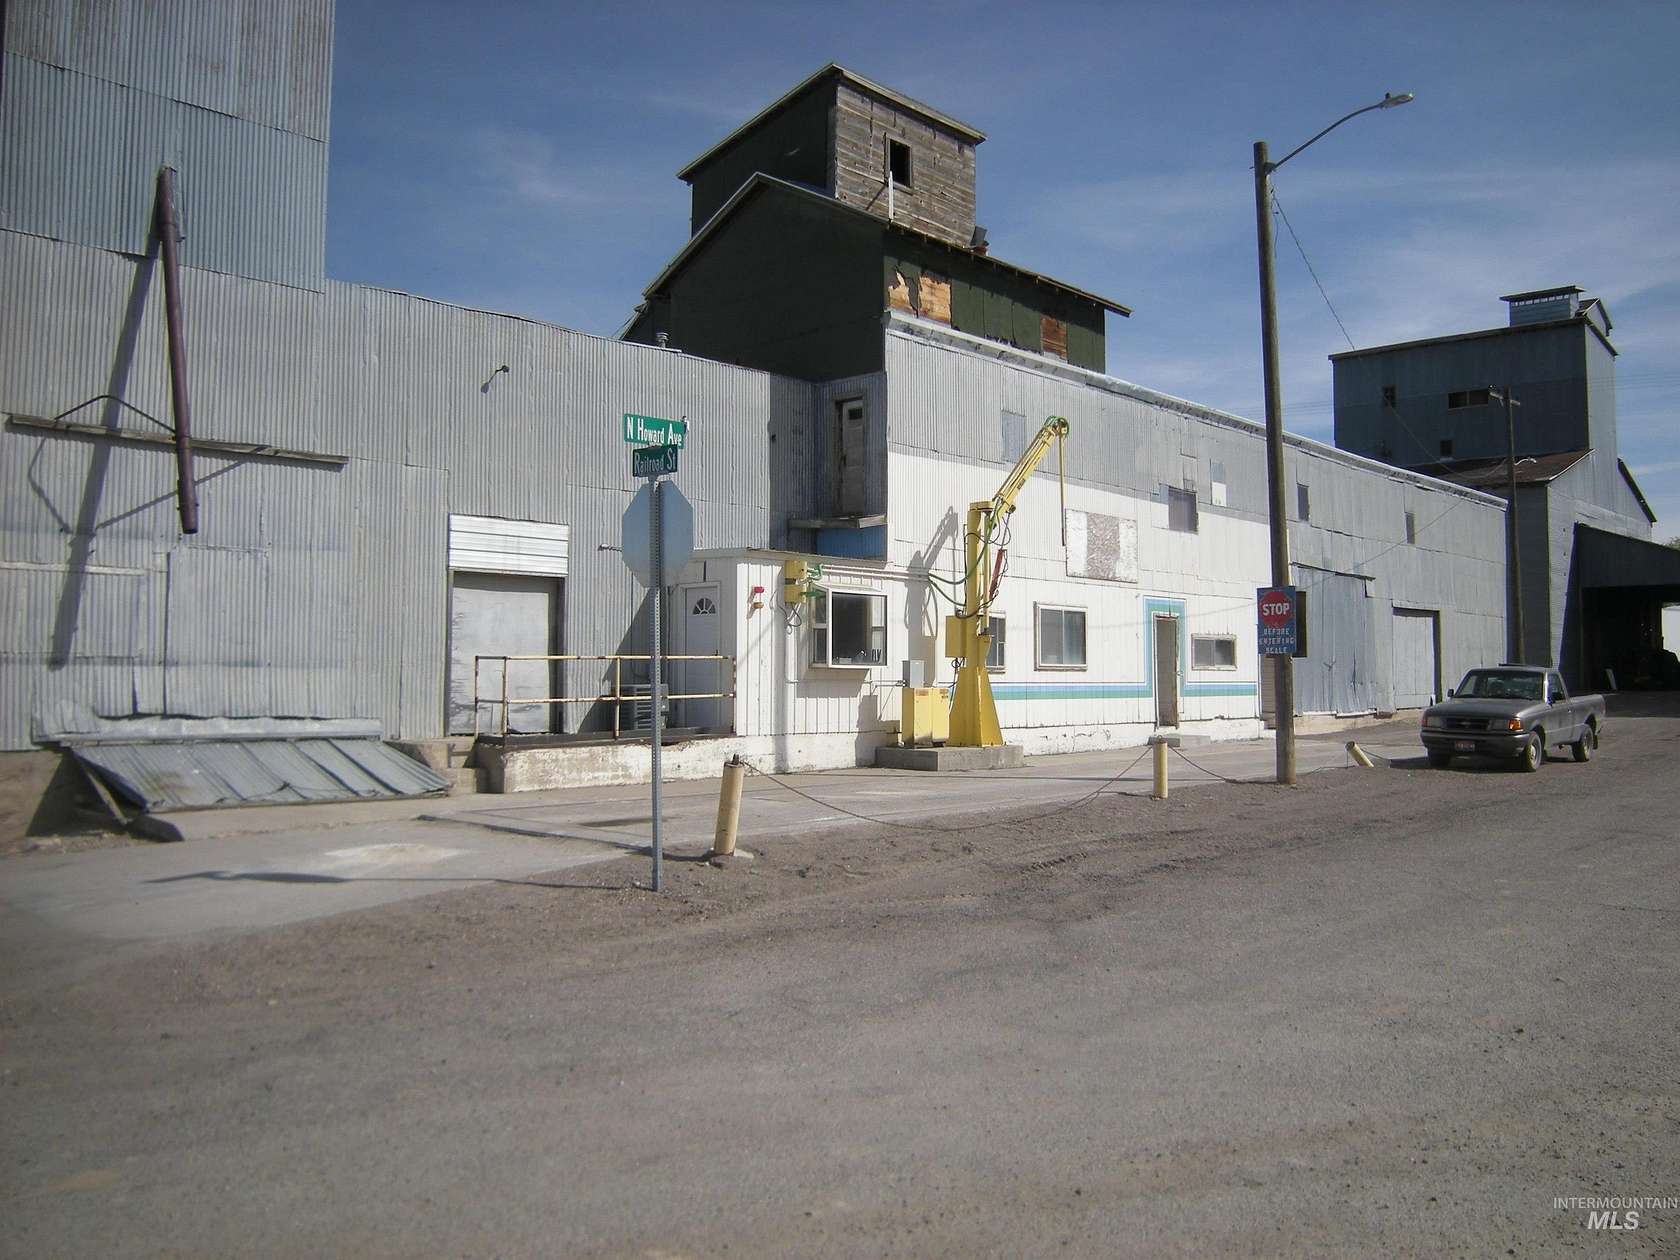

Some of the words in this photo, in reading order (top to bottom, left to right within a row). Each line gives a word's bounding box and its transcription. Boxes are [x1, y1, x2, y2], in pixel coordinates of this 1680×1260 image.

[627, 416, 634, 440] N
[637, 418, 665, 444] Howard
[667, 423, 682, 447] Ave
[634, 452, 665, 475] Railroad
[666, 447, 677, 471] St
[1262, 603, 1290, 616] STOP
